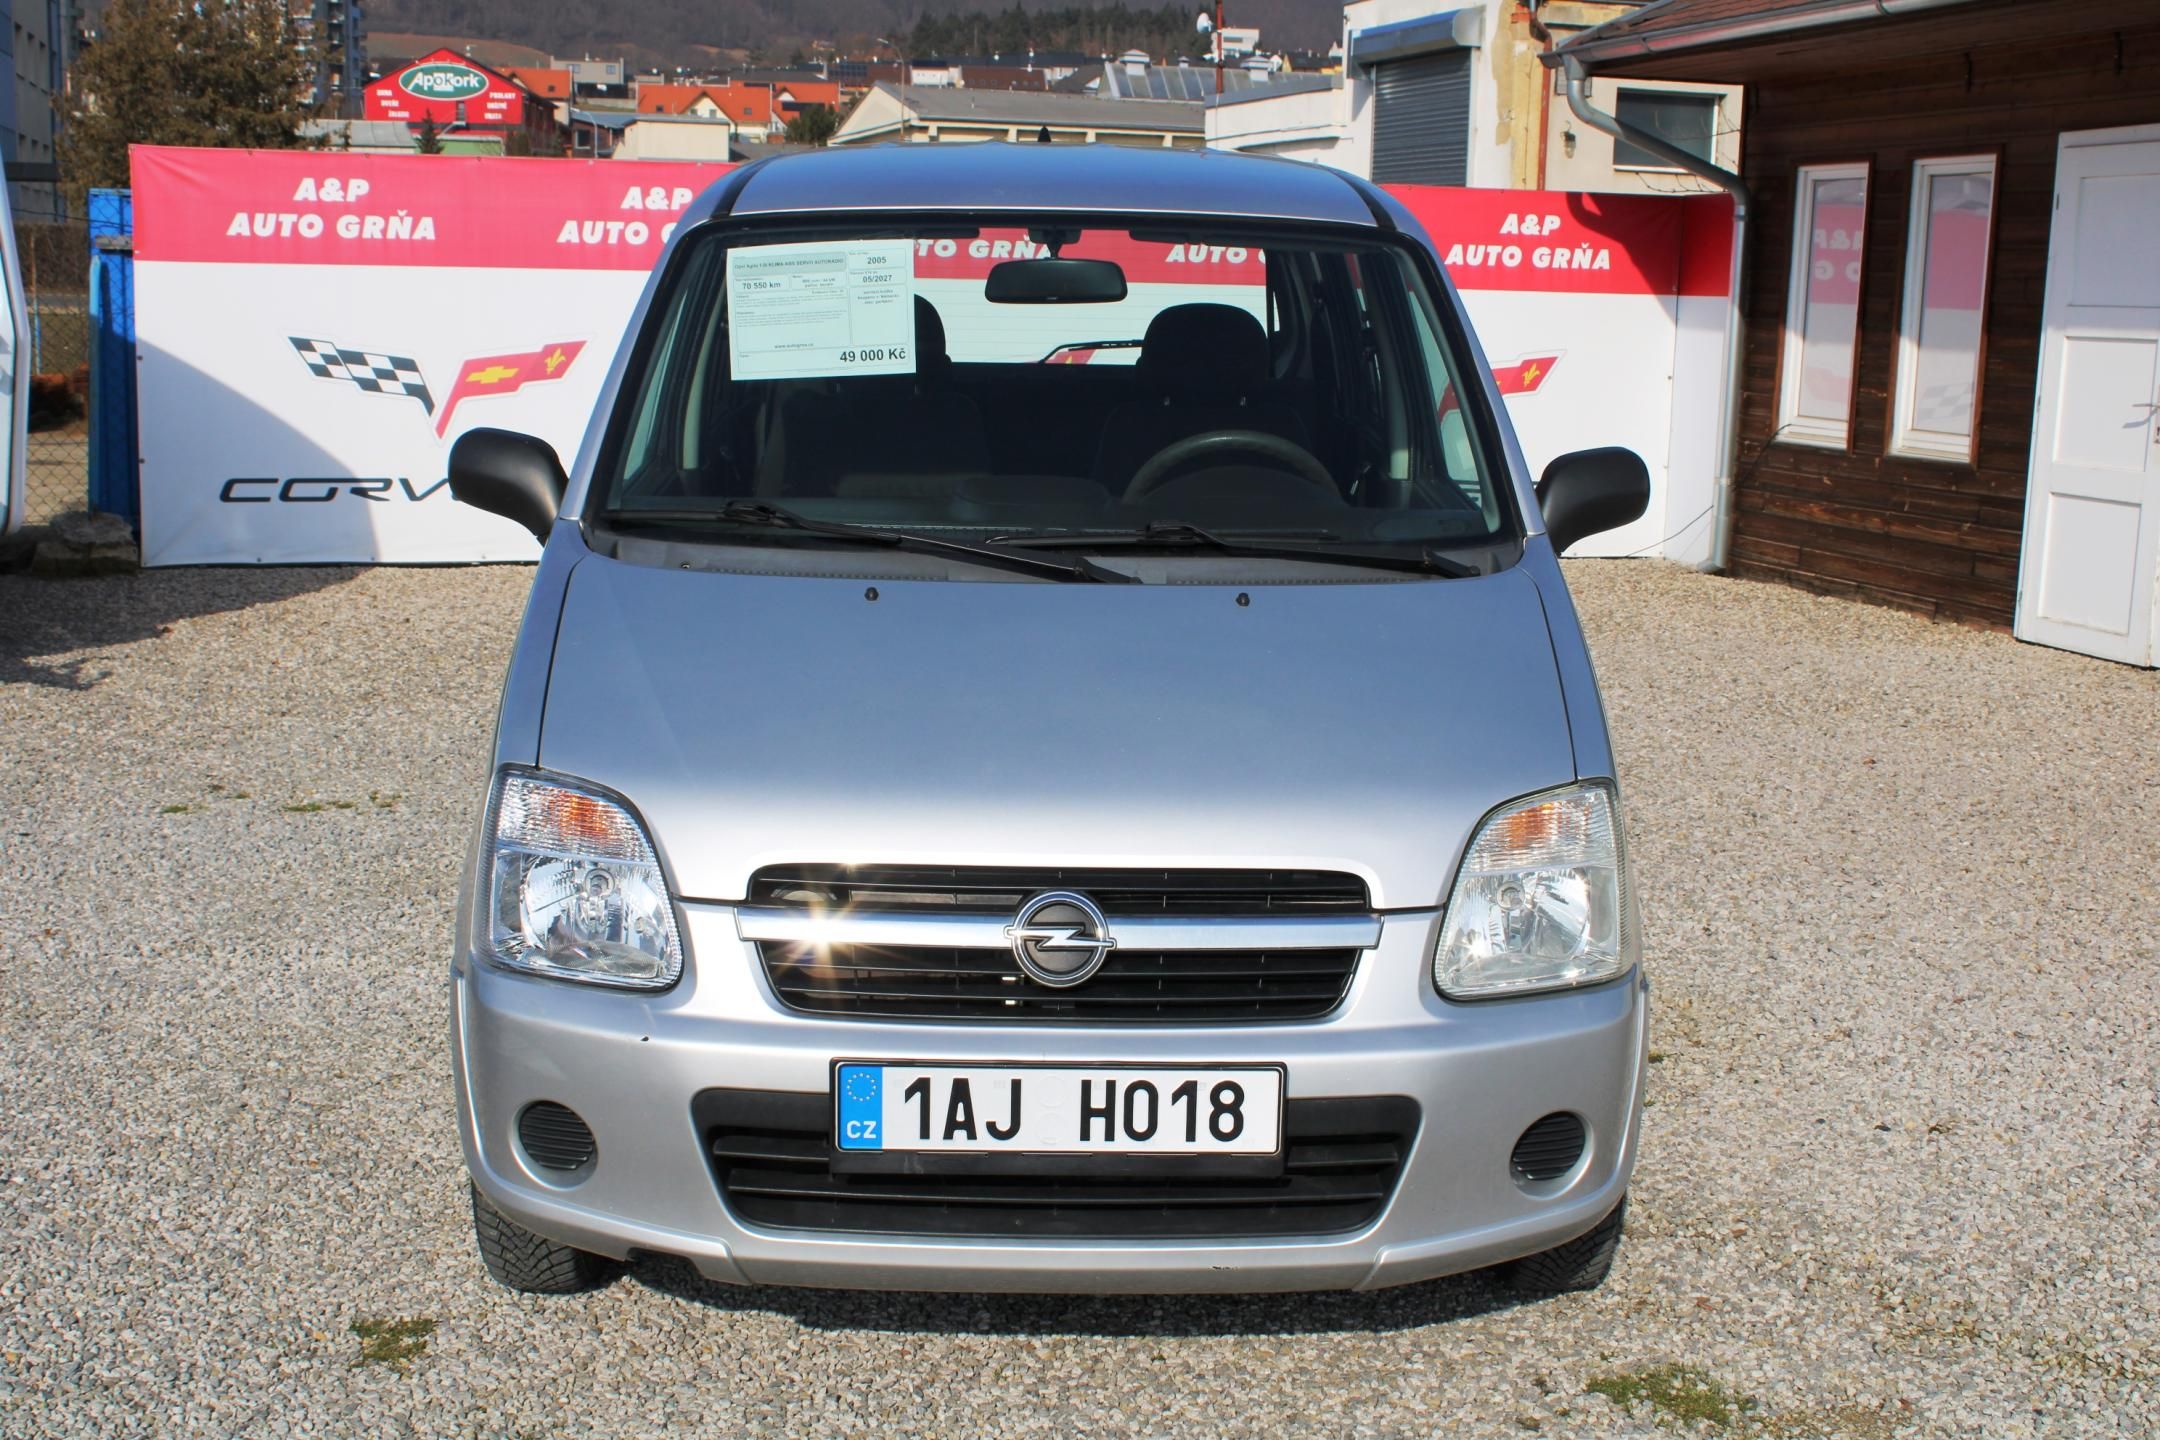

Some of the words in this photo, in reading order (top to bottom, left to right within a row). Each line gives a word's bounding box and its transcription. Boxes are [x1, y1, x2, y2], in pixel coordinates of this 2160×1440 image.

[293, 177, 370, 202] A&P
[620, 186, 693, 210] A&P
[226, 212, 324, 238] AUTO
[336, 209, 435, 240] GRŇA
[556, 220, 649, 245] AUTO
[1499, 213, 1561, 236] A&P
[915, 239, 957, 257] TO
[1165, 243, 1248, 264] AUTO
[1444, 244, 1523, 267] AUTO
[1532, 242, 1610, 270] GRŇA
[867, 256, 887, 264] 2005
[742, 282, 752, 290] 70
[754, 281, 768, 289] 550
[862, 275, 892, 283] 05/2027
[839, 351, 856, 362] 49
[860, 349, 884, 362] 000
[888, 348, 906, 360] Kč
[219, 477, 458, 502] CORV
[904, 1077, 1022, 1141] 1AJ
[1079, 1079, 1245, 1142] H018
[846, 1119, 877, 1139] CZ
